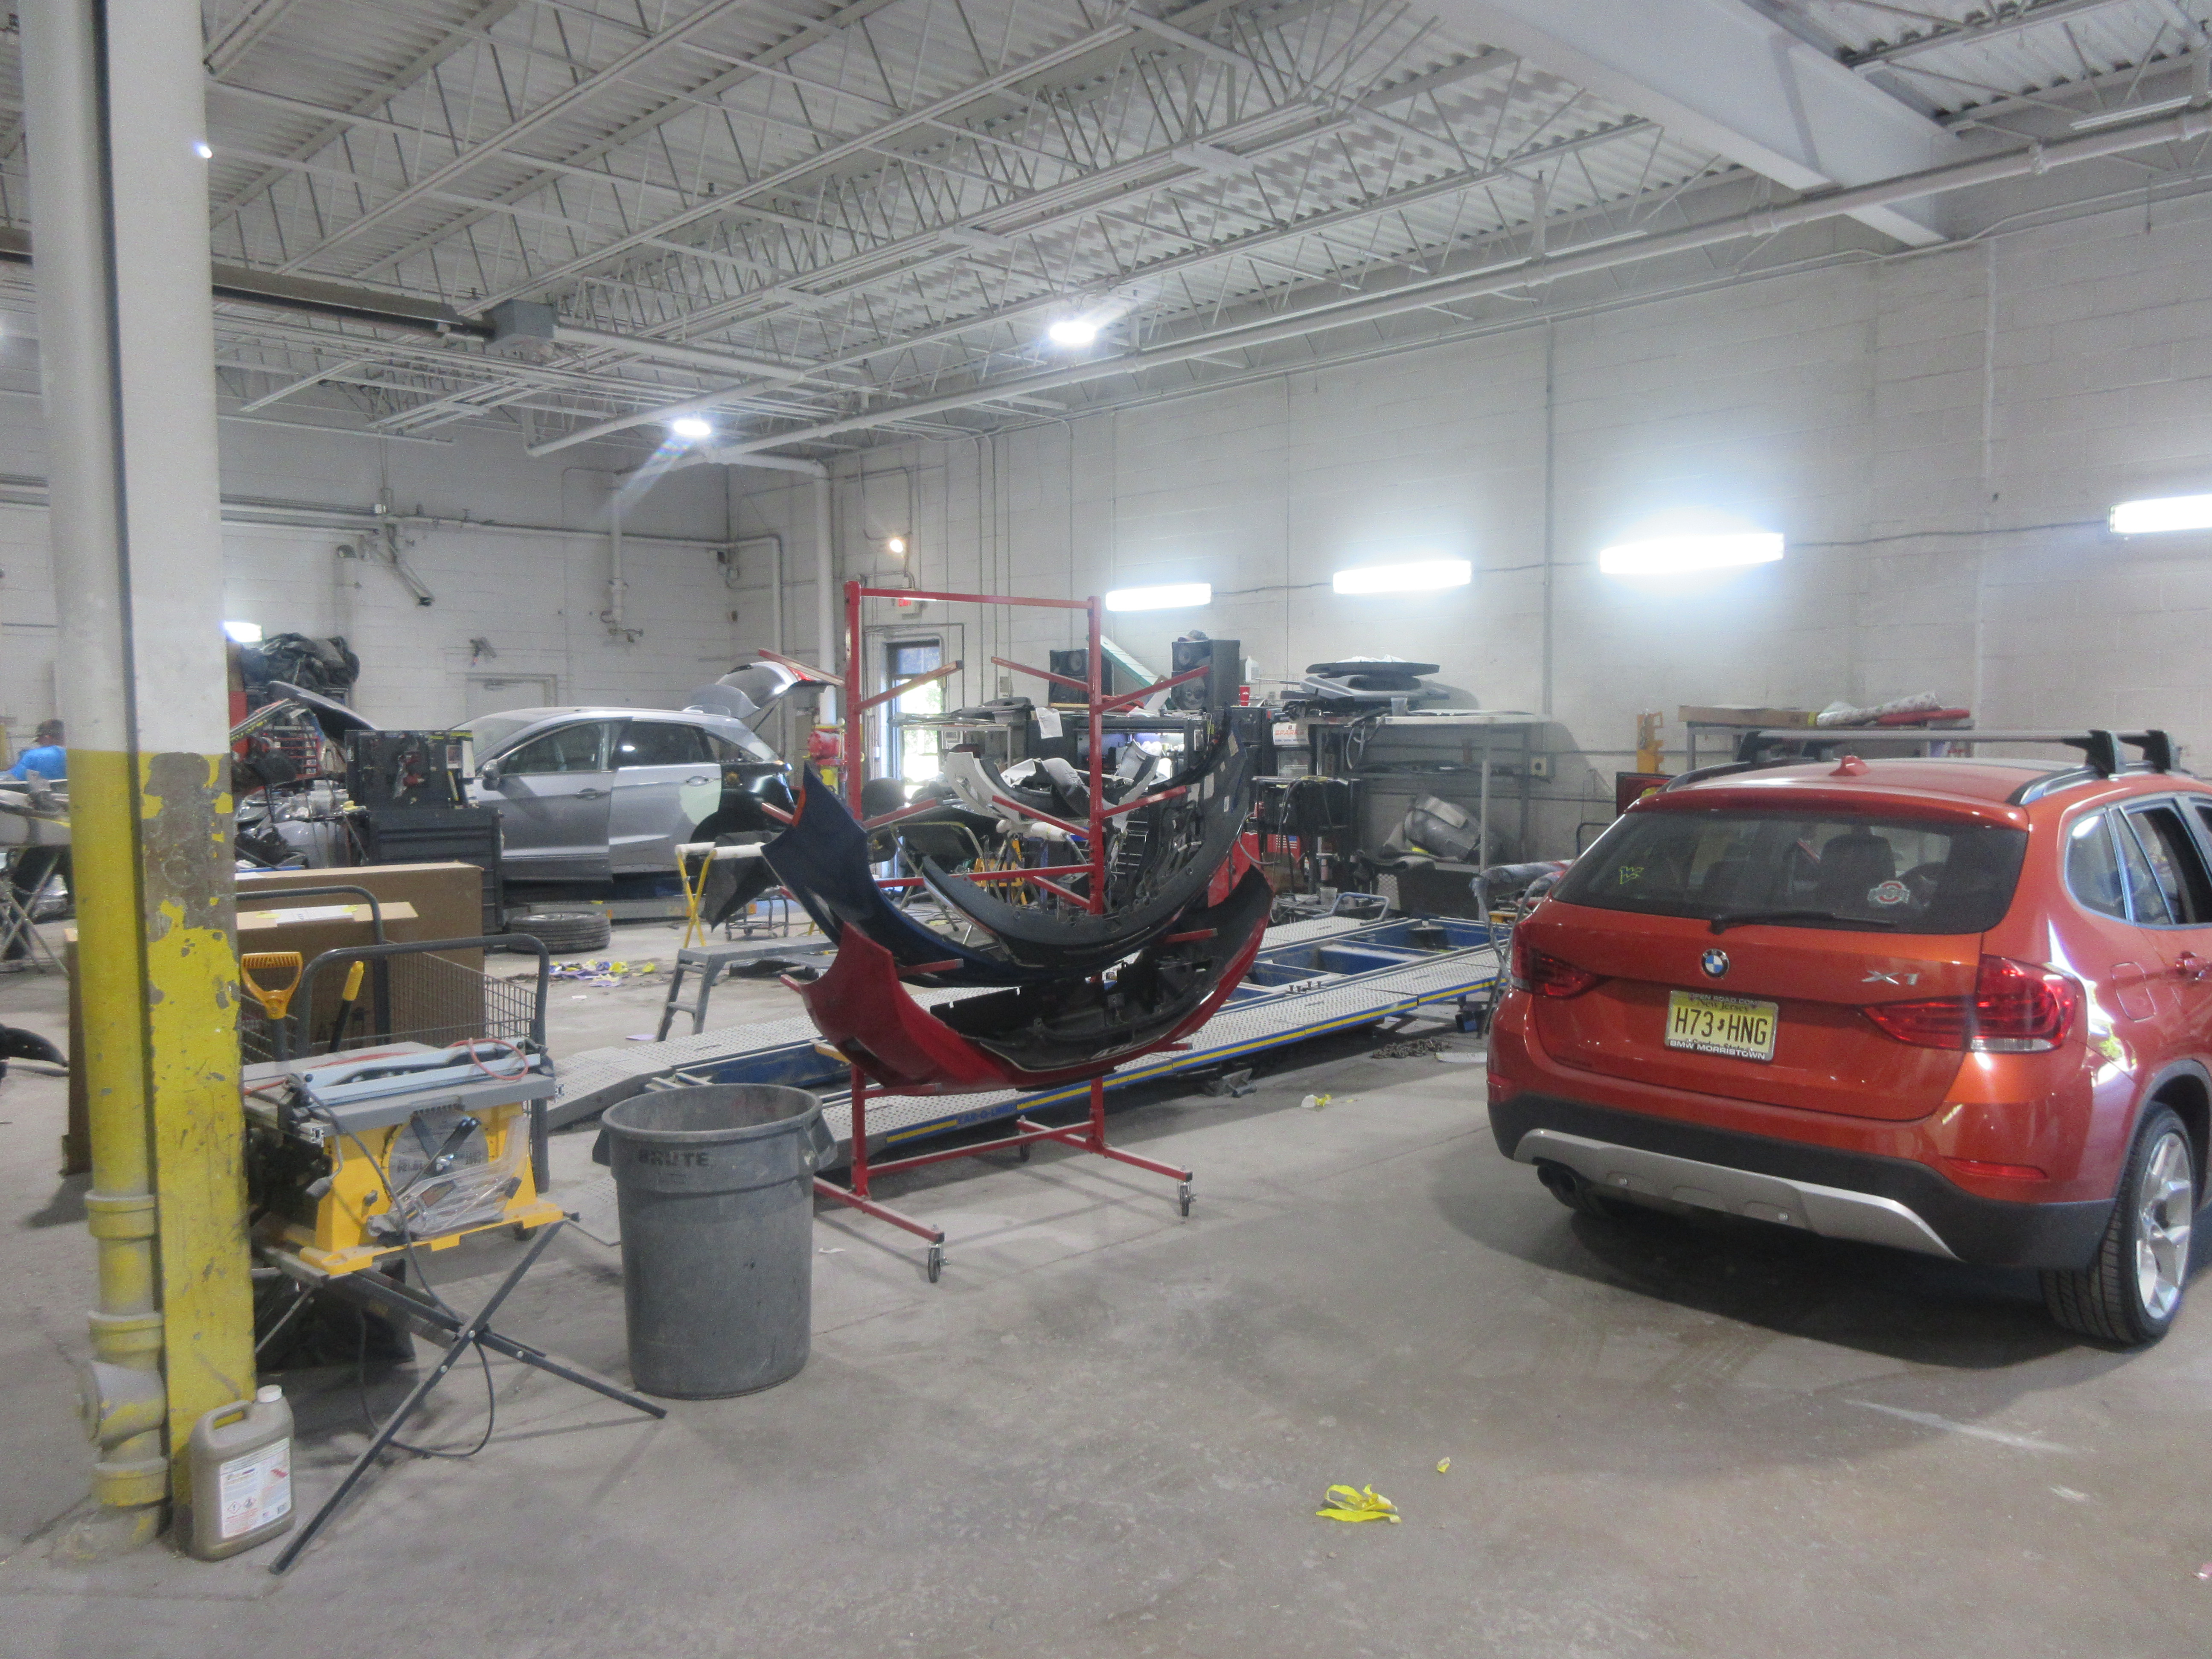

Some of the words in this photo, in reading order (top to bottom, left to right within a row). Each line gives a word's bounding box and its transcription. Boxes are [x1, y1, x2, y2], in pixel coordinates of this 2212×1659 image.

[1861, 970, 1919, 986] X1
[1675, 1007, 1714, 1037] H73
[1727, 1013, 1768, 1045] HNG
[1670, 1040, 1694, 1049] BMW
[1697, 1044, 1765, 1059] MORRISTOWN
